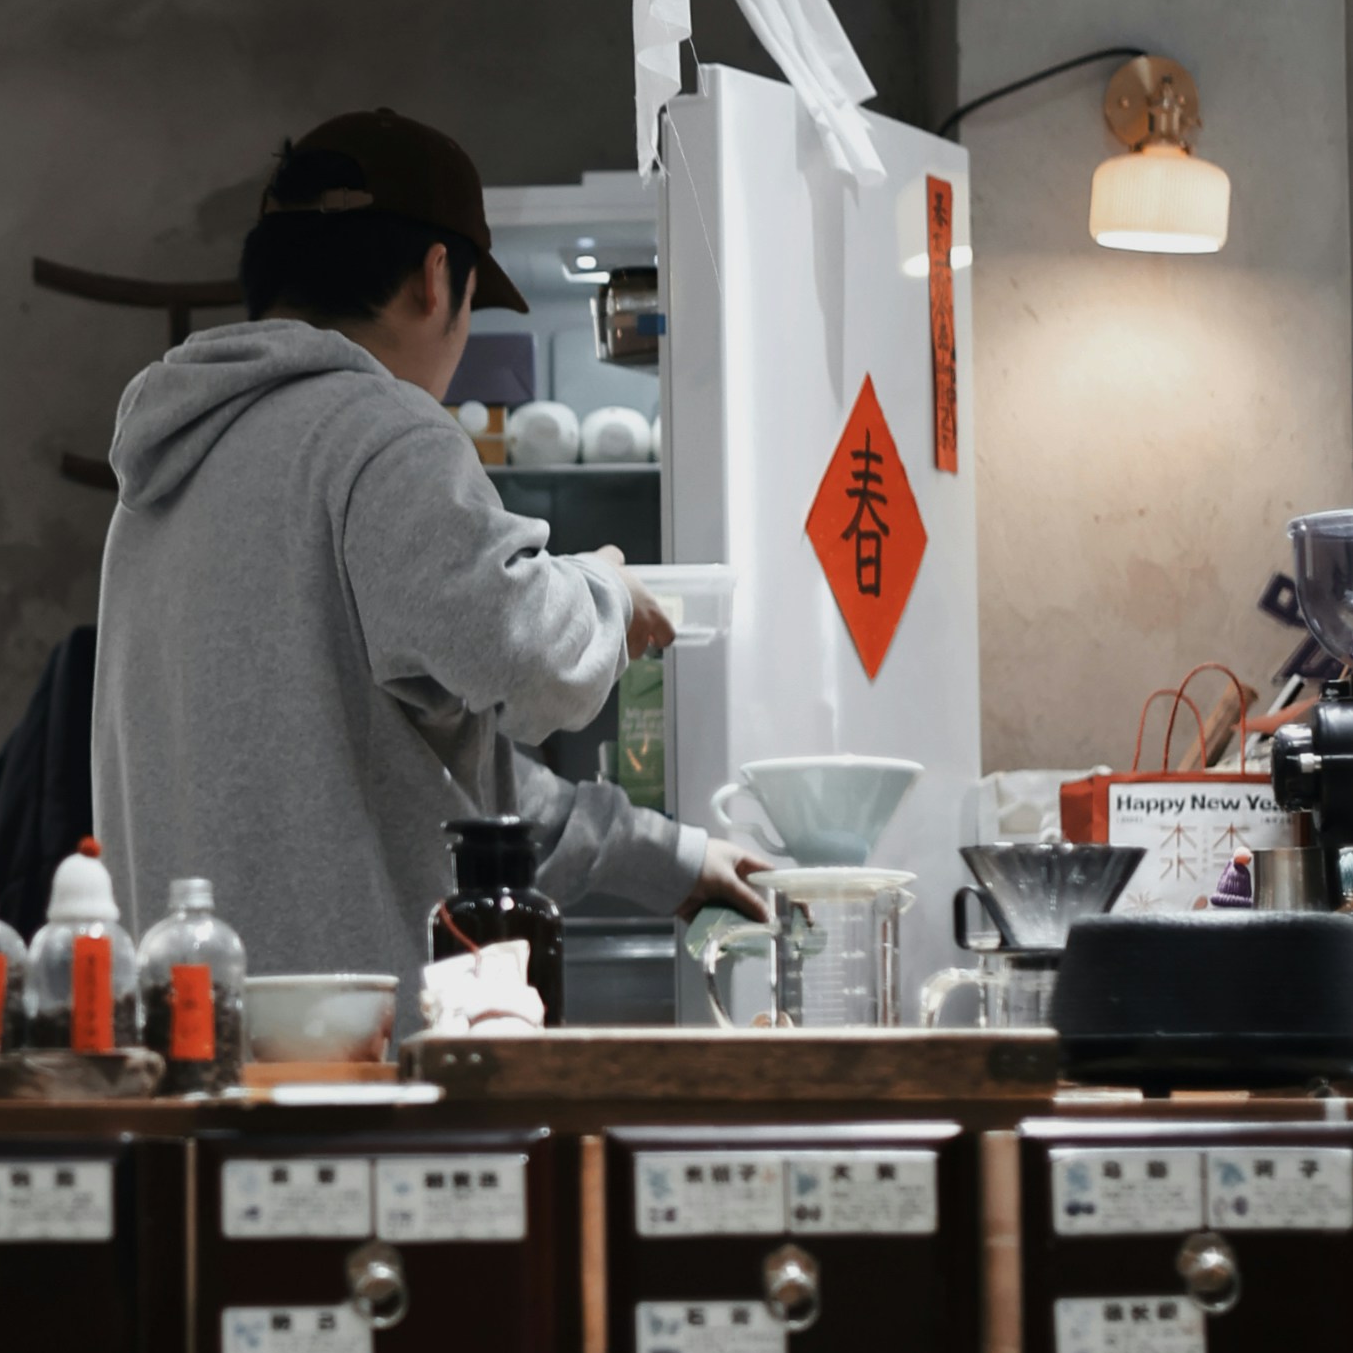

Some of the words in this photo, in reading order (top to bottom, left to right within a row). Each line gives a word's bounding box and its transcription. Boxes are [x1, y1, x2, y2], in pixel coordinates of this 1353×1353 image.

[841, 428, 891, 599] 春
[1116, 794, 1185, 815] Happy
[1191, 794, 1240, 811] New
[1246, 794, 1279, 811] Ye
